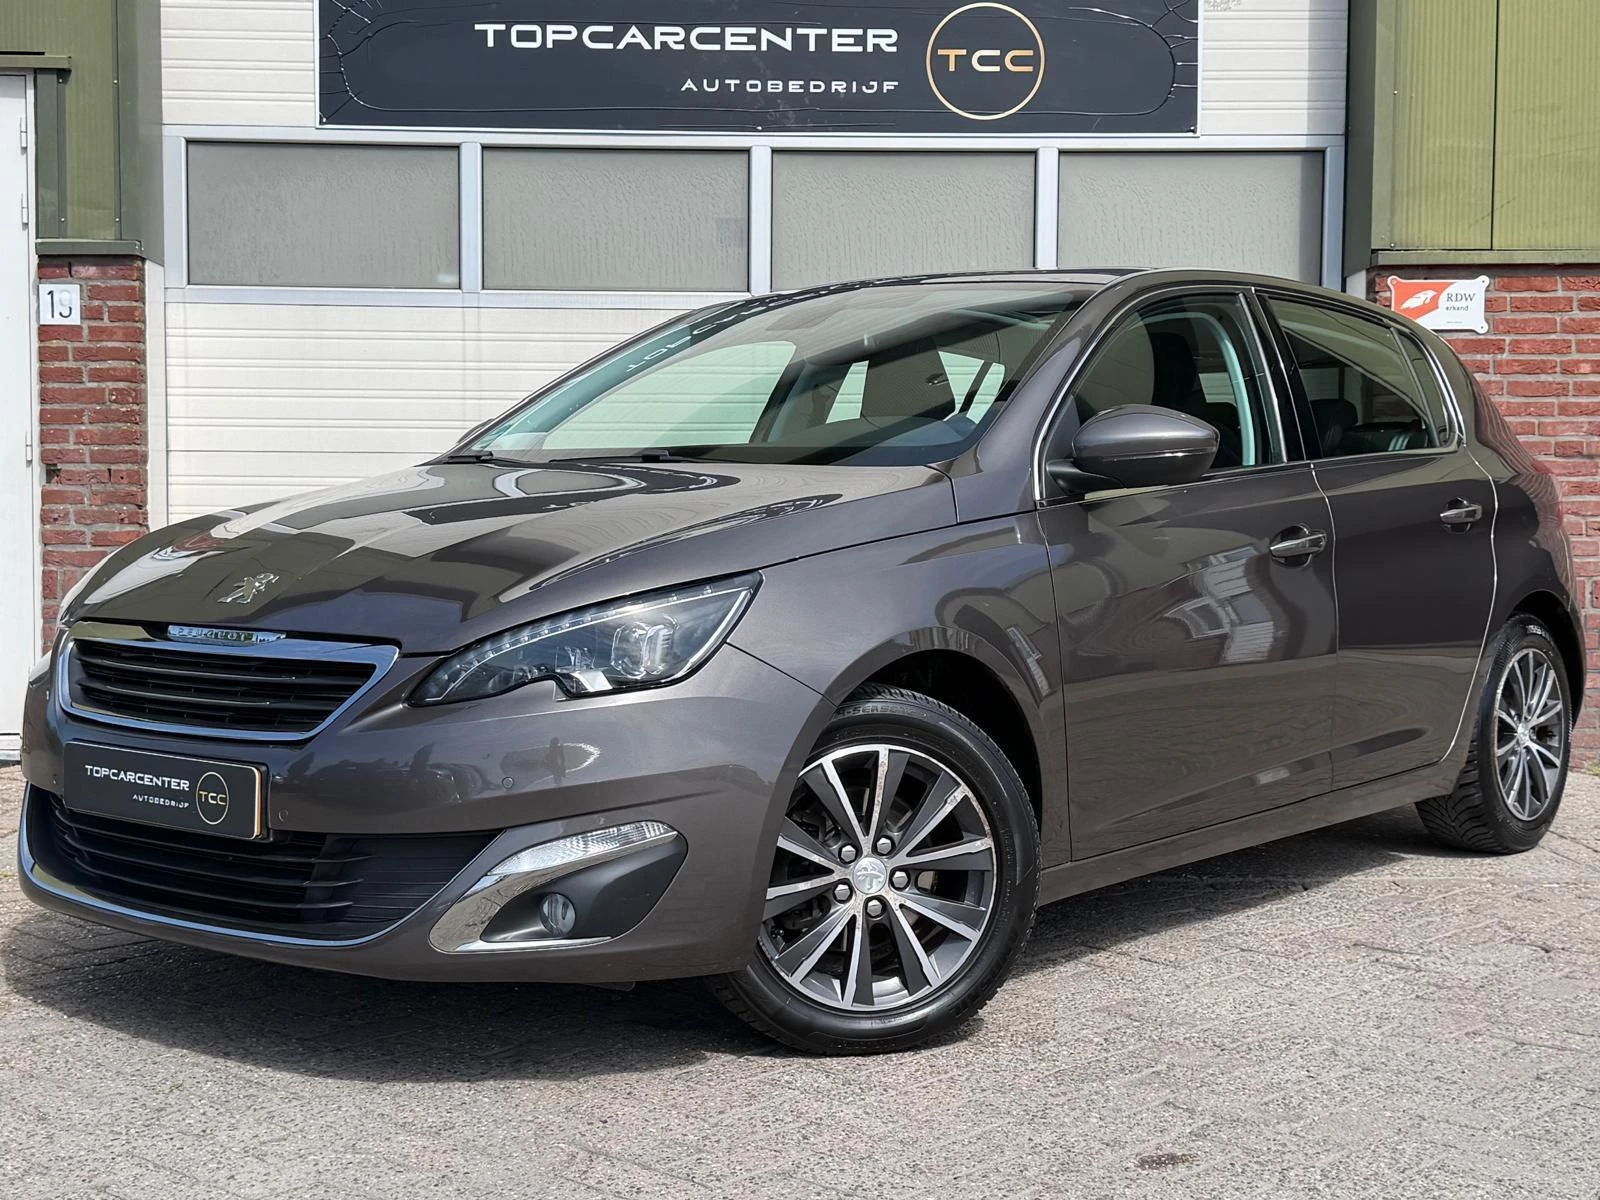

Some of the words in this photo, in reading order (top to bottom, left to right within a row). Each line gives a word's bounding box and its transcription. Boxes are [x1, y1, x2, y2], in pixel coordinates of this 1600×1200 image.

[474, 24, 899, 53] TOPCARCENTER
[937, 48, 1034, 73] TCC
[681, 78, 899, 94] AUTOBEDRIJF
[1446, 292, 1476, 303] RDW
[85, 765, 190, 791] TOPCARCENTER
[132, 793, 189, 808] AUTOBEDRIJF
[199, 790, 227, 806] TCC
